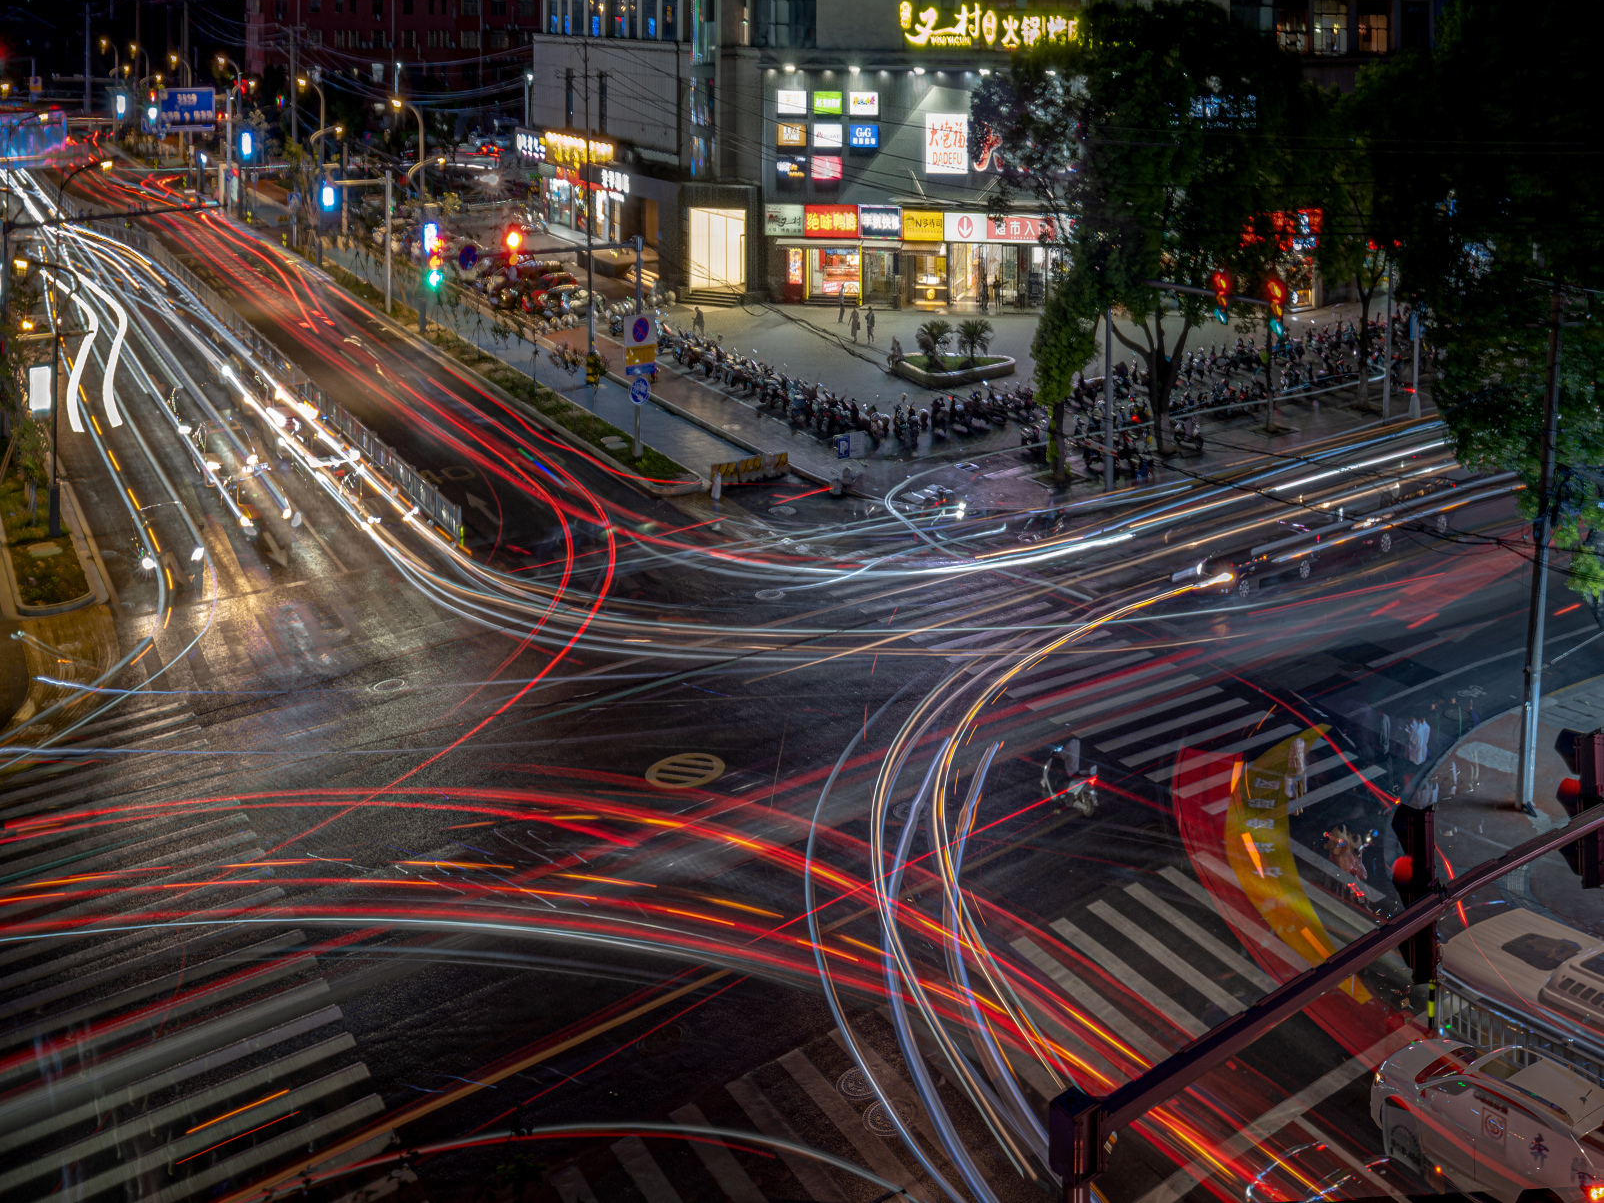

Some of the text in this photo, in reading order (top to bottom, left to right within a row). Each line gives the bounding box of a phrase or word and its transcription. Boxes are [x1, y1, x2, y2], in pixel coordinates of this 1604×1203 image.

[932, 151, 963, 165] DADEFU
[806, 211, 858, 232] 绝味鸭脖
[862, 213, 900, 231] 手机快修
